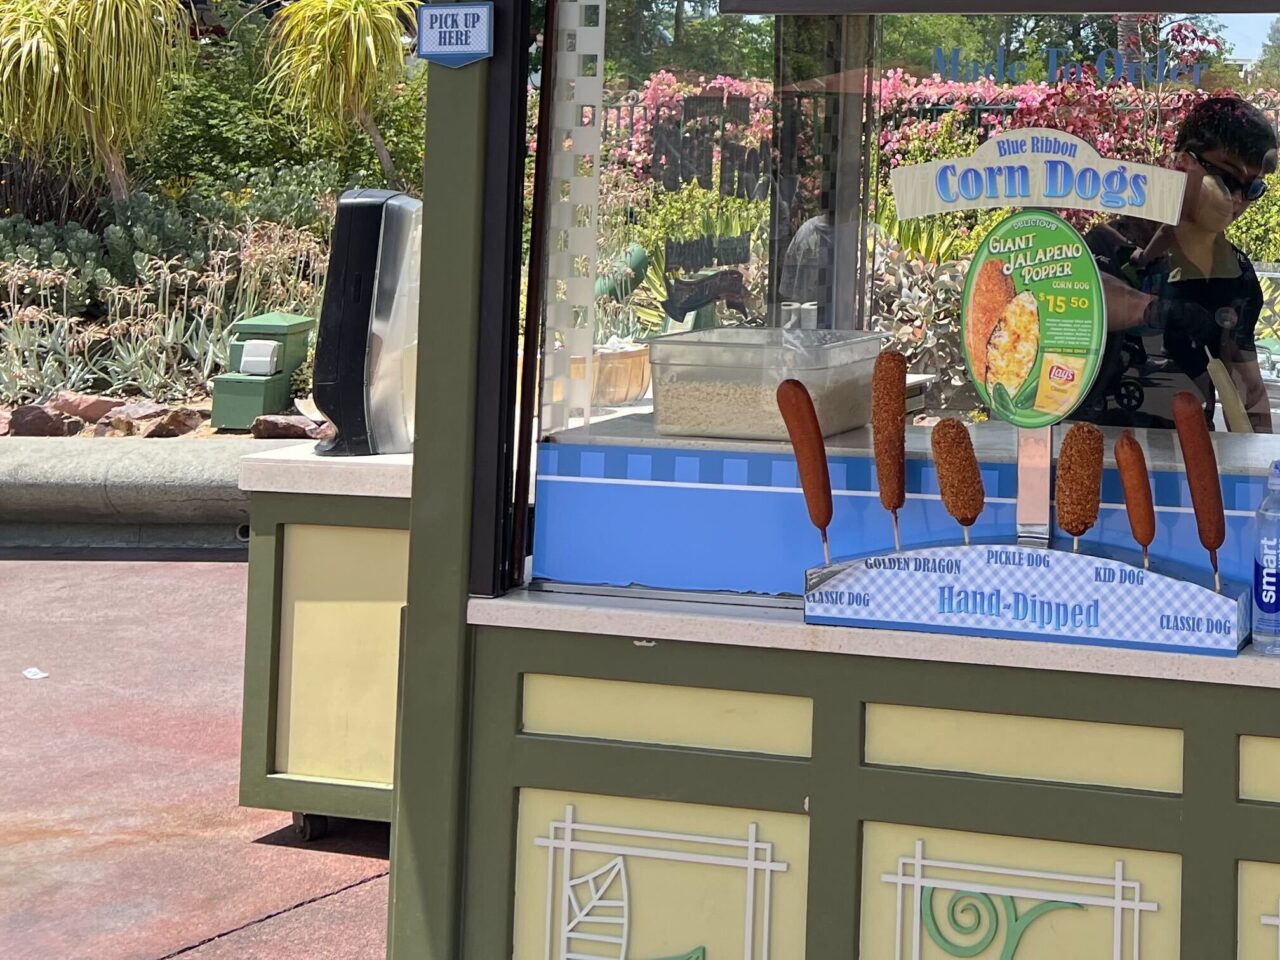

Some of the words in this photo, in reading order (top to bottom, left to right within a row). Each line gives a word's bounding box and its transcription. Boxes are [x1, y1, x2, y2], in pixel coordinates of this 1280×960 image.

[429, 13, 459, 29] PICK
[464, 13, 480, 28] UP
[438, 30, 471, 46] HERE
[997, 137, 1027, 158] Blue
[1030, 136, 1078, 159] Ribbon
[935, 161, 1030, 203] Corn
[1043, 159, 1148, 209] Dogs
[1012, 218, 1058, 231] DELICIOUS
[988, 232, 1036, 254] GIANT
[1021, 261, 1073, 285] POPPER
[1052, 280, 1072, 289] CORN
[1074, 281, 1090, 290] DOG
[864, 557, 910, 571] GOLDEN
[913, 557, 962, 575] DRAGON
[986, 549, 1024, 566] PICKLE
[1027, 553, 1050, 568] DOG
[1094, 566, 1115, 583] KID
[1119, 568, 1145, 586] DOG
[1260, 536, 1277, 604] smart
[806, 590, 845, 605] CLASSIC
[847, 591, 870, 607] DOG
[1159, 614, 1204, 633] CLASSIC
[1206, 616, 1231, 635] DOG
